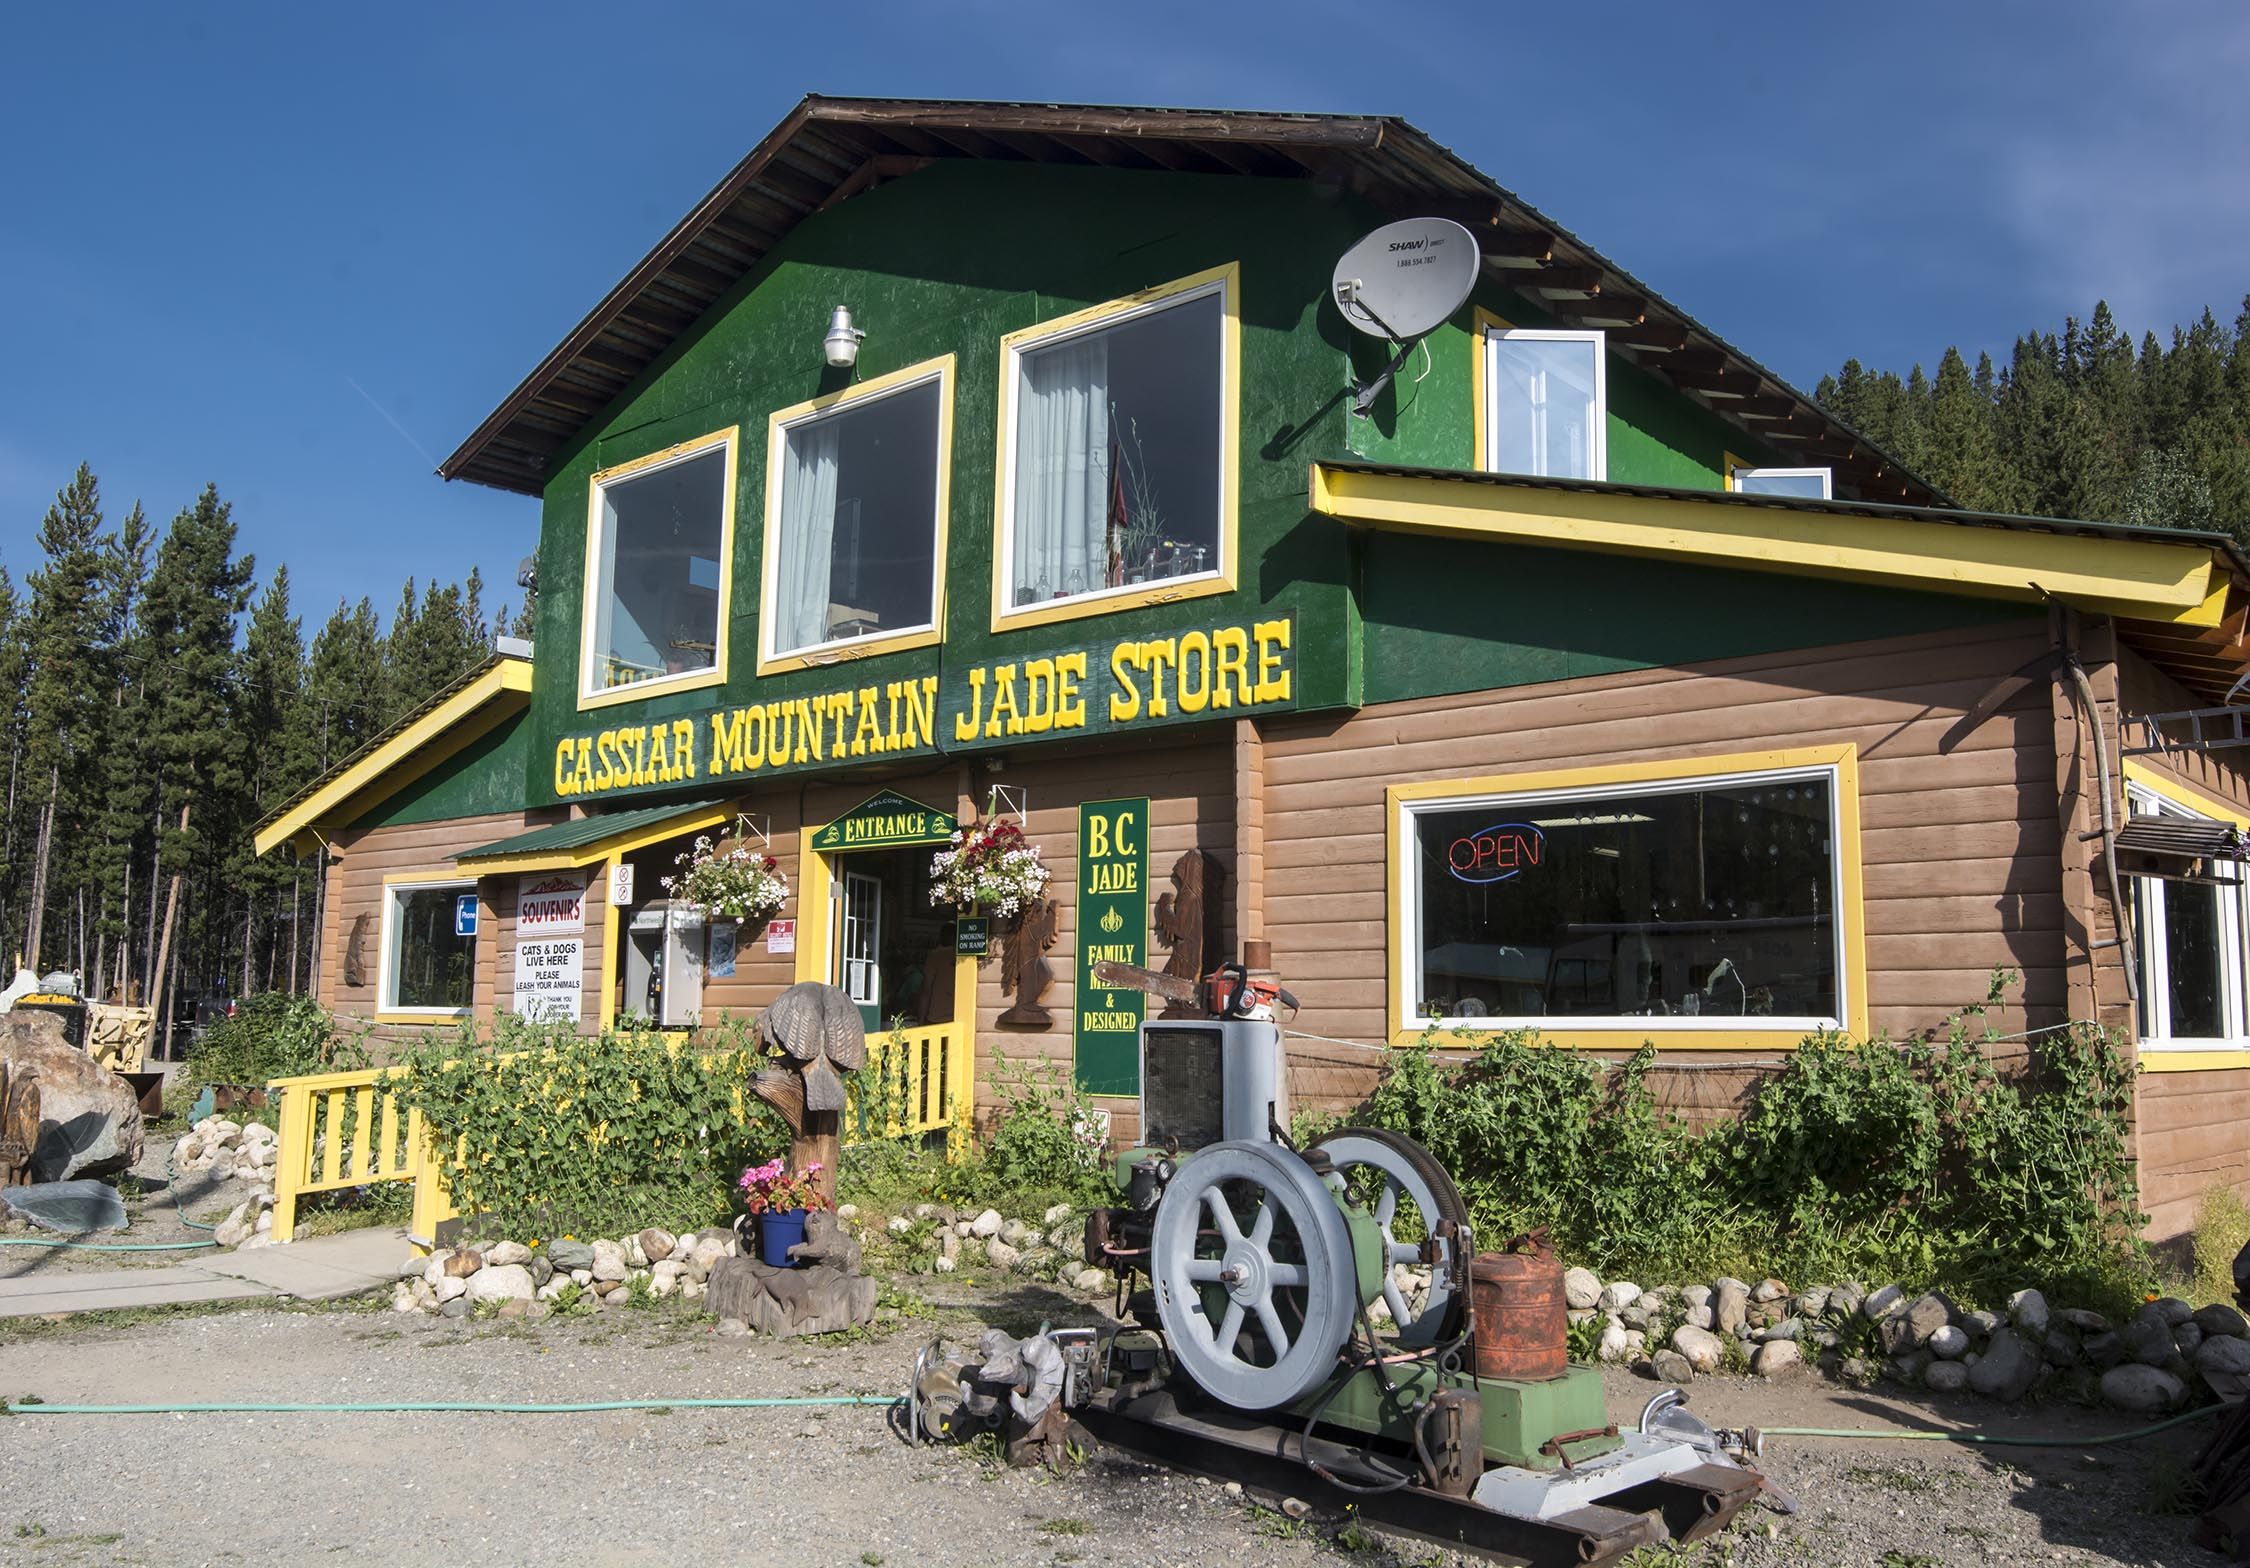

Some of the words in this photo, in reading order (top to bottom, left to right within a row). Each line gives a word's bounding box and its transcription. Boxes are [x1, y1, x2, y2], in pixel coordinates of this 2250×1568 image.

[1388, 240, 1424, 252] SHAW
[555, 718, 695, 797] CASSIAR
[709, 675, 938, 775] MOUNTAIN
[955, 651, 1087, 742] JADE
[1109, 618, 1291, 722] STORE
[867, 798, 903, 809] WELCOME
[845, 812, 926, 842] ENTRANCE
[1088, 812, 1137, 858] B.C.
[1449, 834, 1539, 870] OPEN
[1088, 862, 1137, 894] JADE
[462, 911, 476, 919] Phone
[521, 898, 580, 924] SOUVENIRS
[521, 945, 542, 955] CATS
[544, 945, 550, 955] &
[553, 943, 576, 954] DOGS
[1087, 944, 1135, 966] FAMILY
[526, 956, 544, 966] LIVE
[546, 955, 568, 966] HERE
[535, 970, 560, 980] PLEASE
[516, 982, 534, 990] LEASH
[536, 981, 552, 989] YOUR
[553, 980, 580, 989] ANIMALS
[1105, 993, 1114, 1009] &
[1083, 1012, 1136, 1031] DESIGNED
